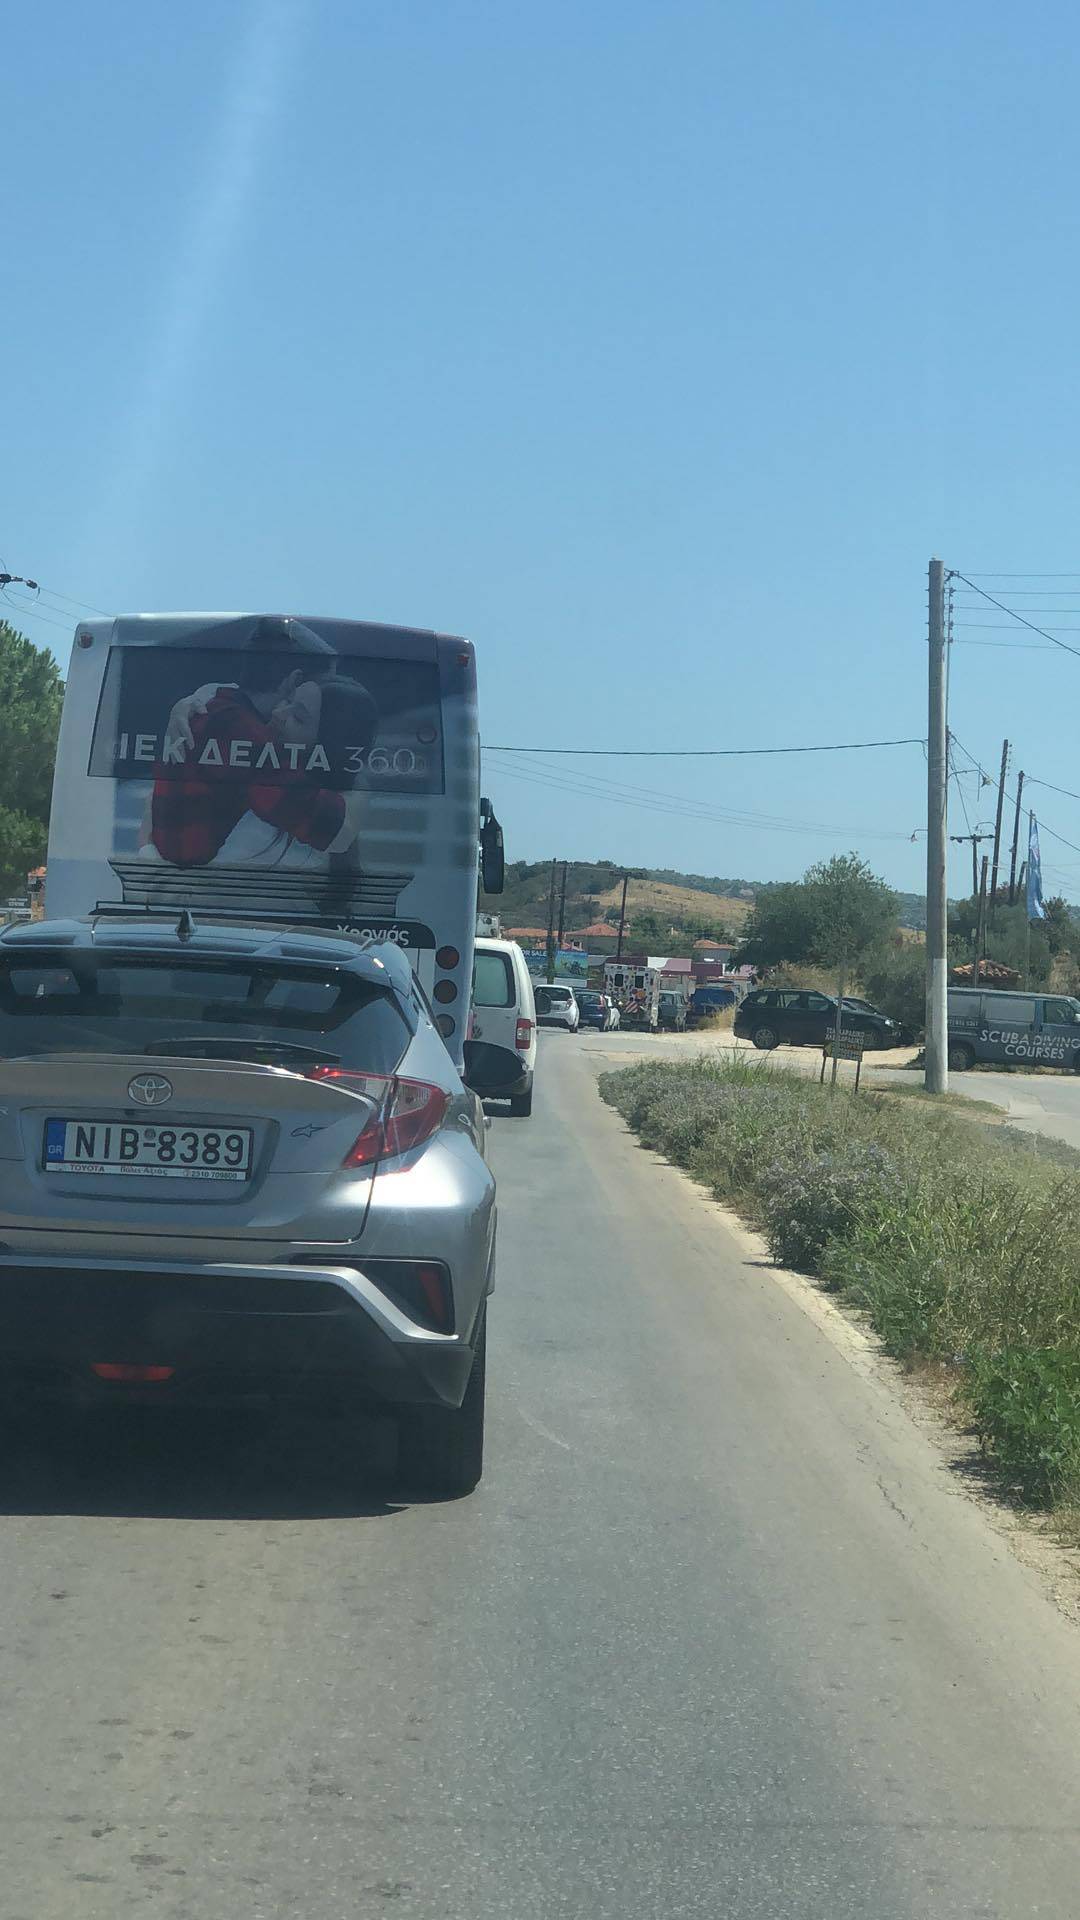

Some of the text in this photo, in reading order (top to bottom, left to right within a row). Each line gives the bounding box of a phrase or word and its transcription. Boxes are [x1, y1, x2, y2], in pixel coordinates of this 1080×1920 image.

[118, 732, 416, 775] ΙΕΚ ΔΕΛΤΑ 360
[980, 1029, 1080, 1049] SCUBA DIVING
[1004, 1044, 1065, 1059] COURSES
[48, 1145, 64, 1156] GR
[75, 1125, 244, 1166] NIB-8389
[70, 1164, 105, 1173] TOYOTA
